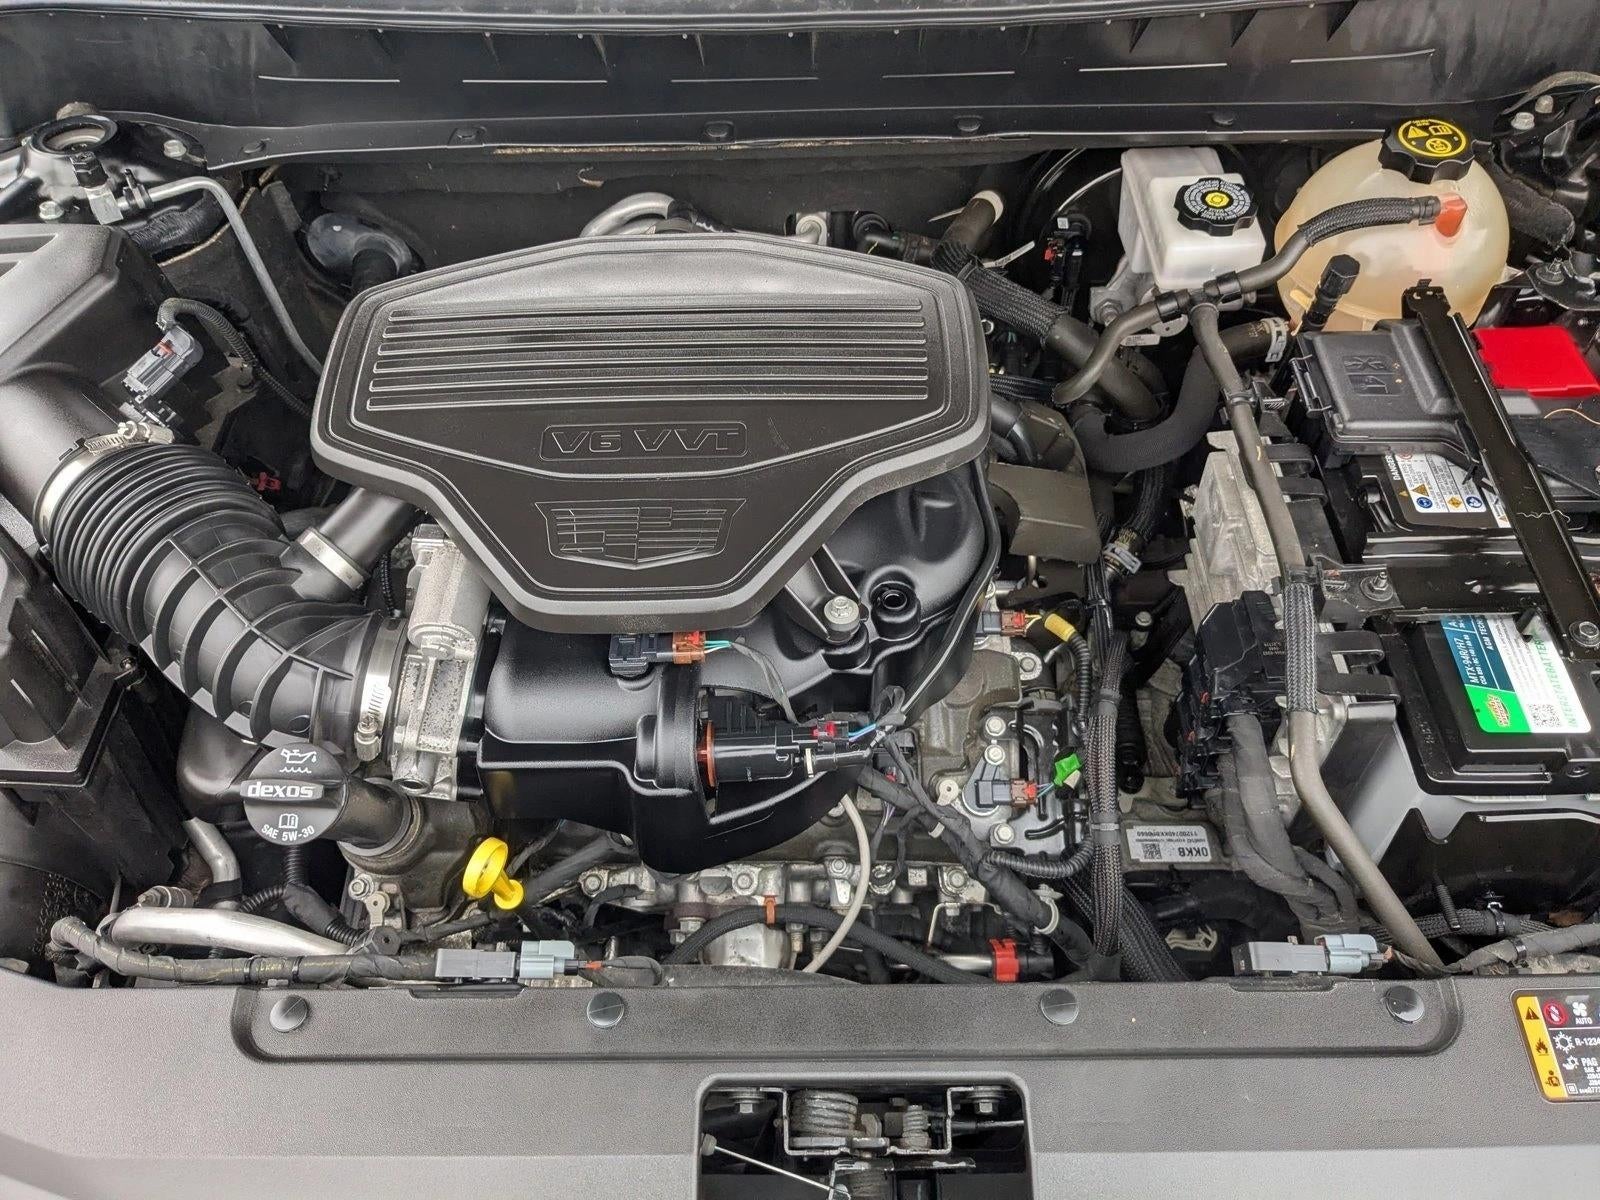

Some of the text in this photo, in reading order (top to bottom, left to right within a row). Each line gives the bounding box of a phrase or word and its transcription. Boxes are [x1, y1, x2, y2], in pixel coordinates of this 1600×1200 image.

[551, 428, 739, 453] V6 VVT
[1385, 454, 1402, 480] DANGER
[1454, 638, 1479, 683] MTX-94R/H7
[247, 782, 315, 798] dexos
[261, 824, 315, 842] SAE 5W-30
[1575, 1017, 1593, 1025] AUTO
[1580, 1057, 1598, 1067] PAG
